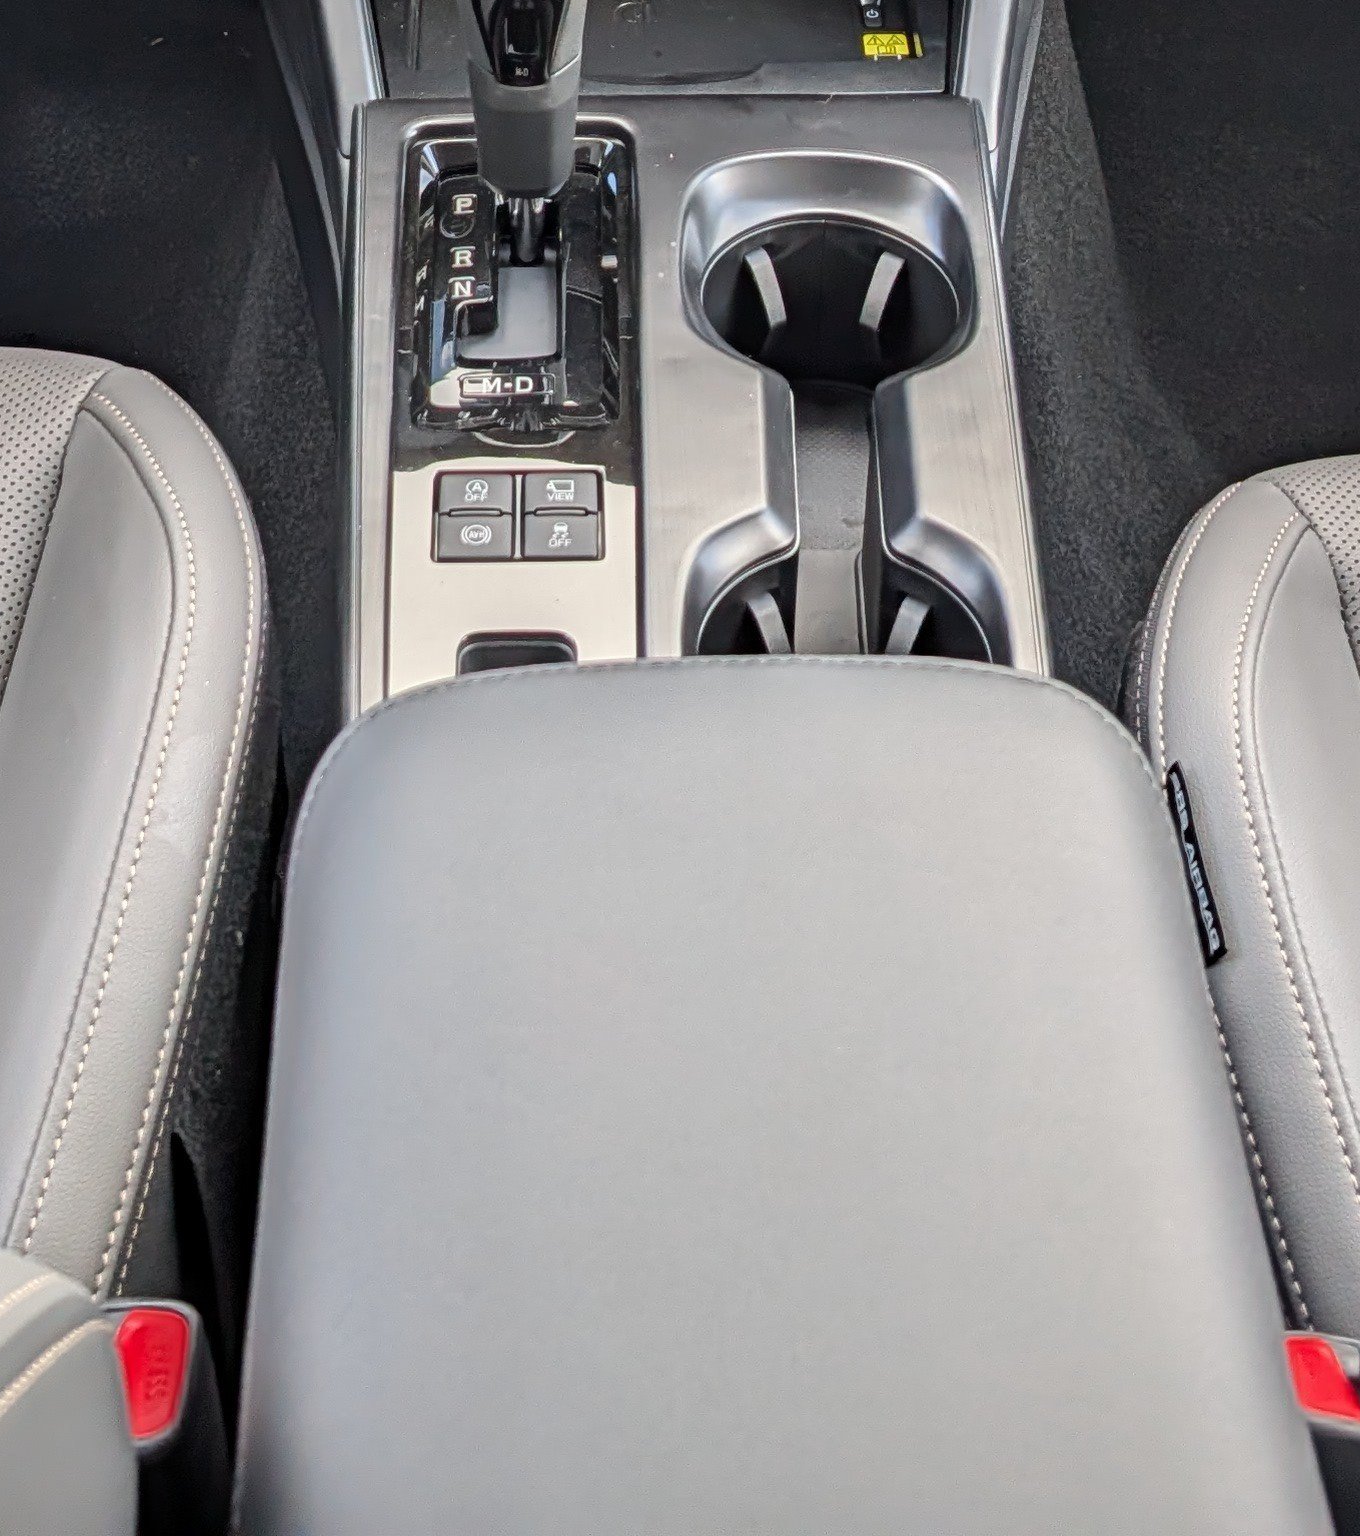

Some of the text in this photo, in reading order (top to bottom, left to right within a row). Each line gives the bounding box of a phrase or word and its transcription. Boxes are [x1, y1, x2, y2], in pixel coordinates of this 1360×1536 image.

[455, 197, 473, 212] P
[454, 250, 473, 265] R
[455, 282, 472, 296] N
[465, 492, 488, 502] OFF
[547, 492, 575, 502] VIEW
[548, 538, 573, 548] OFF
